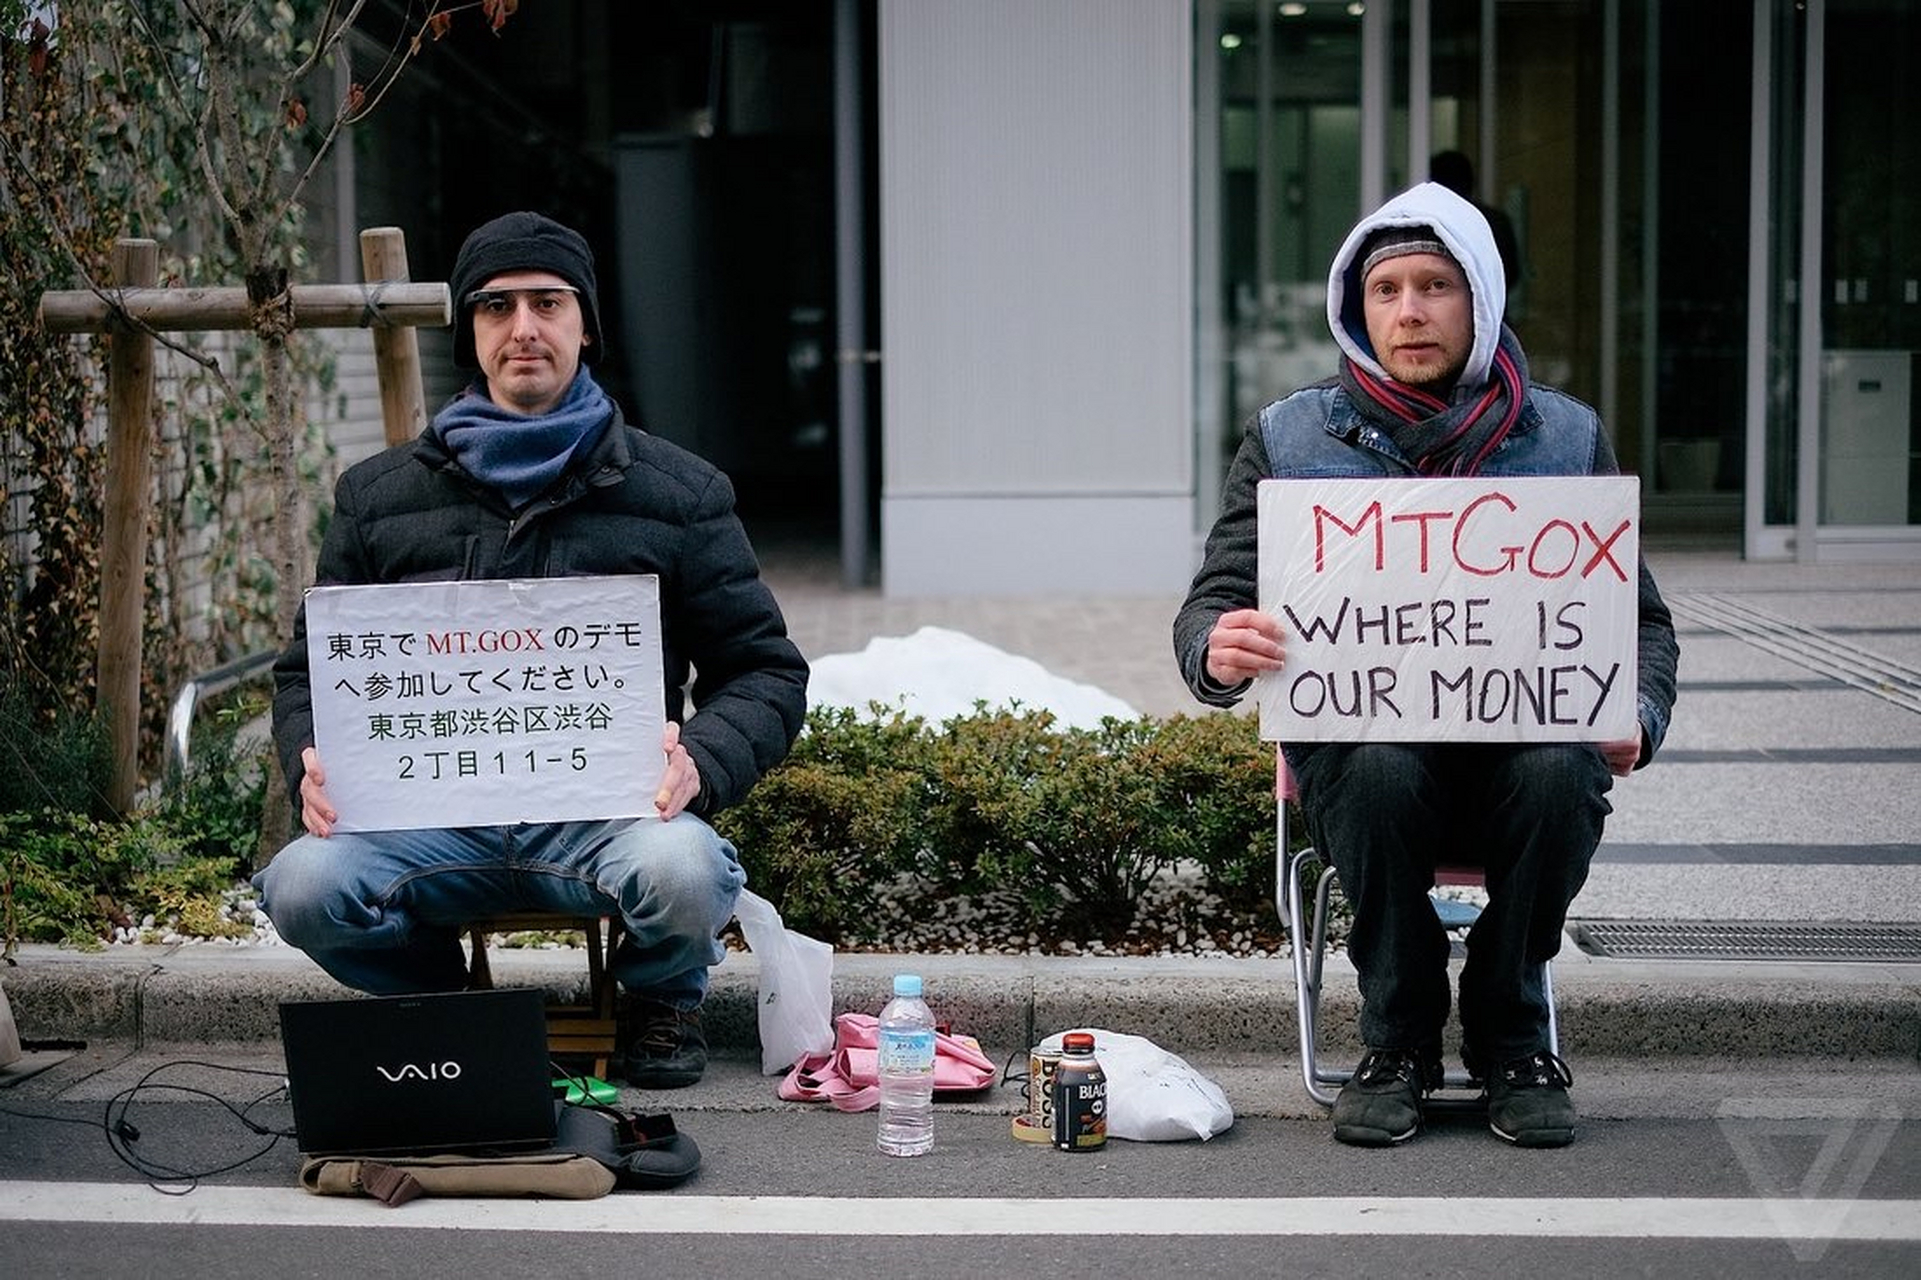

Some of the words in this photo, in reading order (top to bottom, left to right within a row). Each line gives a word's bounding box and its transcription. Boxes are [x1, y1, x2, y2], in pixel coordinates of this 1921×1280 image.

[327, 631, 417, 662] 東京で
[426, 628, 545, 655] MT.GOX
[553, 621, 642, 650] のデモ
[1283, 597, 1493, 647] WHERE
[1537, 601, 1587, 651] IS
[334, 664, 626, 701] へ参加してください。
[1289, 666, 1402, 719] OUR
[1430, 663, 1620, 727] MONEY
[367, 702, 613, 741] 東京都渋谷区渋谷
[376, 1061, 462, 1082] VAIO
